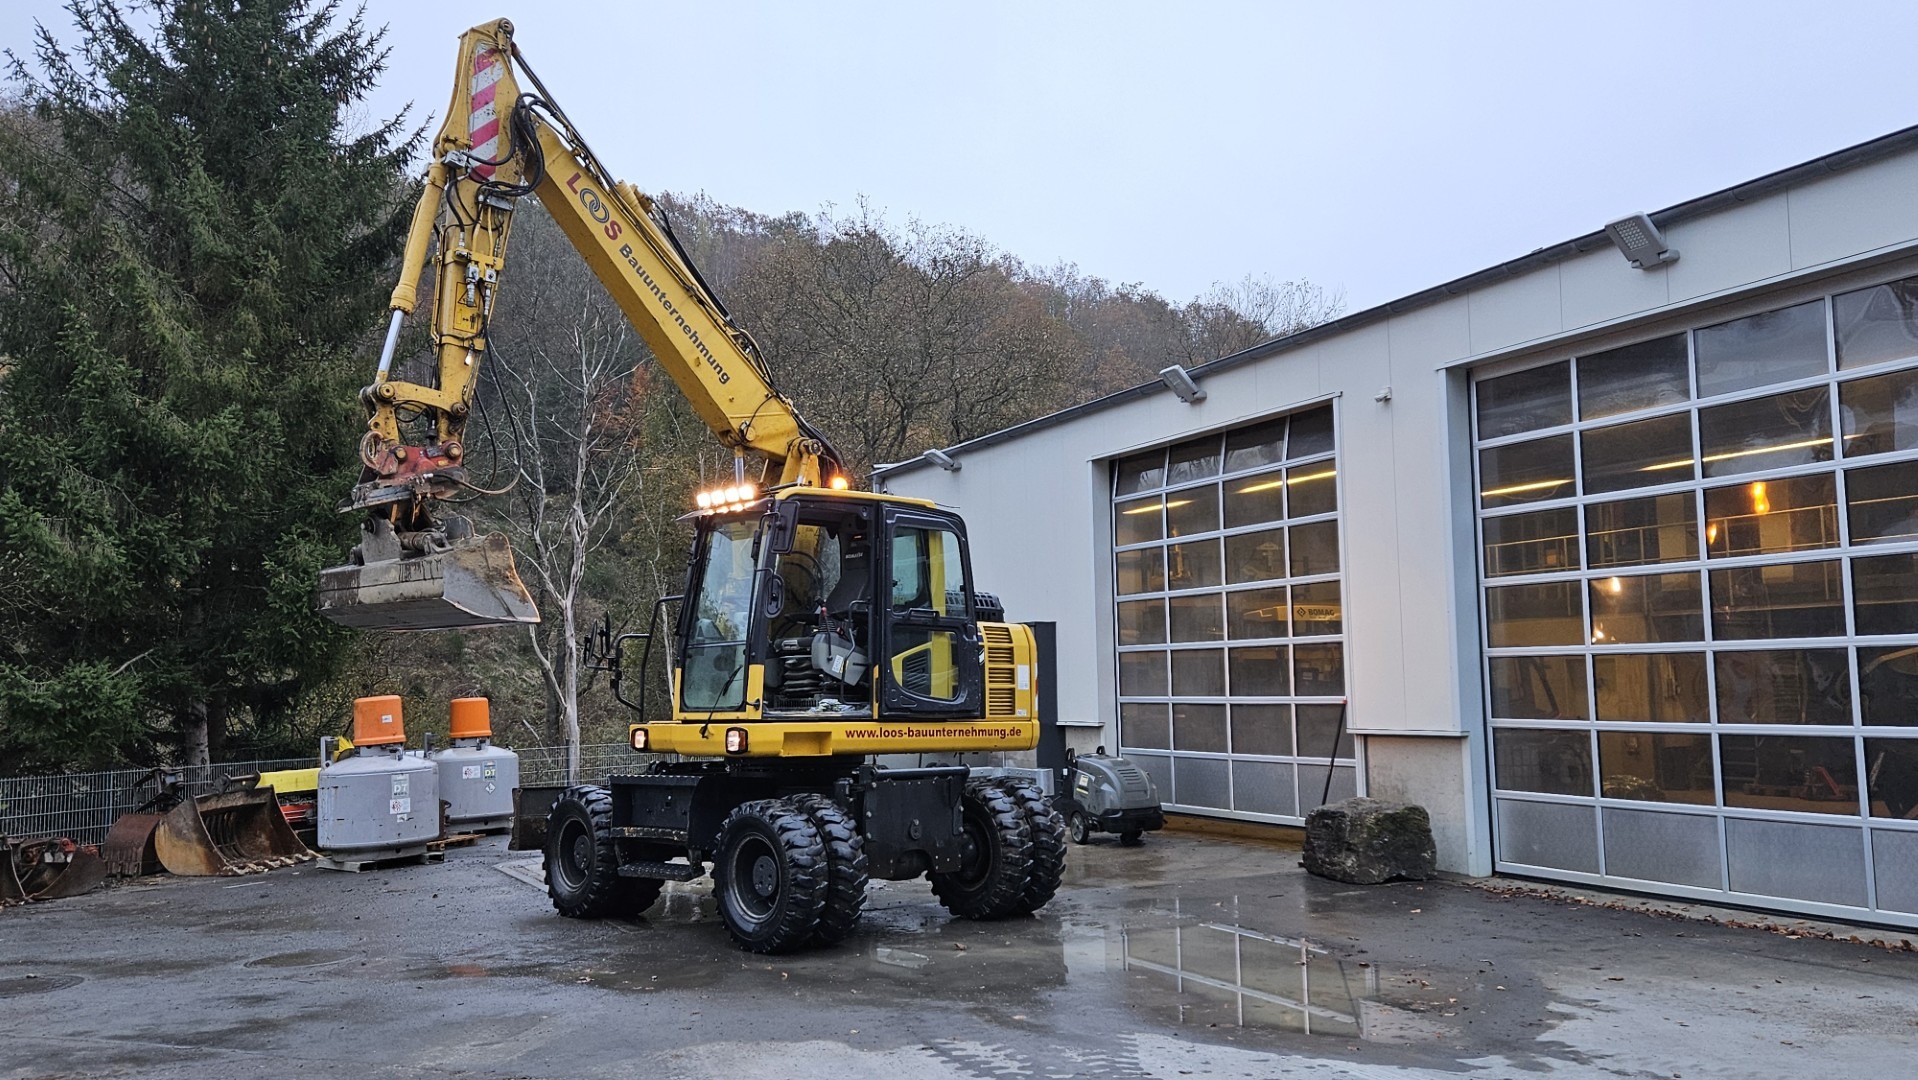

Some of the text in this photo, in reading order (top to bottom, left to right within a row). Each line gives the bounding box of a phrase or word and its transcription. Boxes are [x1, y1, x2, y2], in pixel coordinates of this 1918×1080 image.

[566, 172, 730, 385] LOOS Bauunternehmung
[845, 726, 1022, 739] www.loos-bauunternehmung.de
